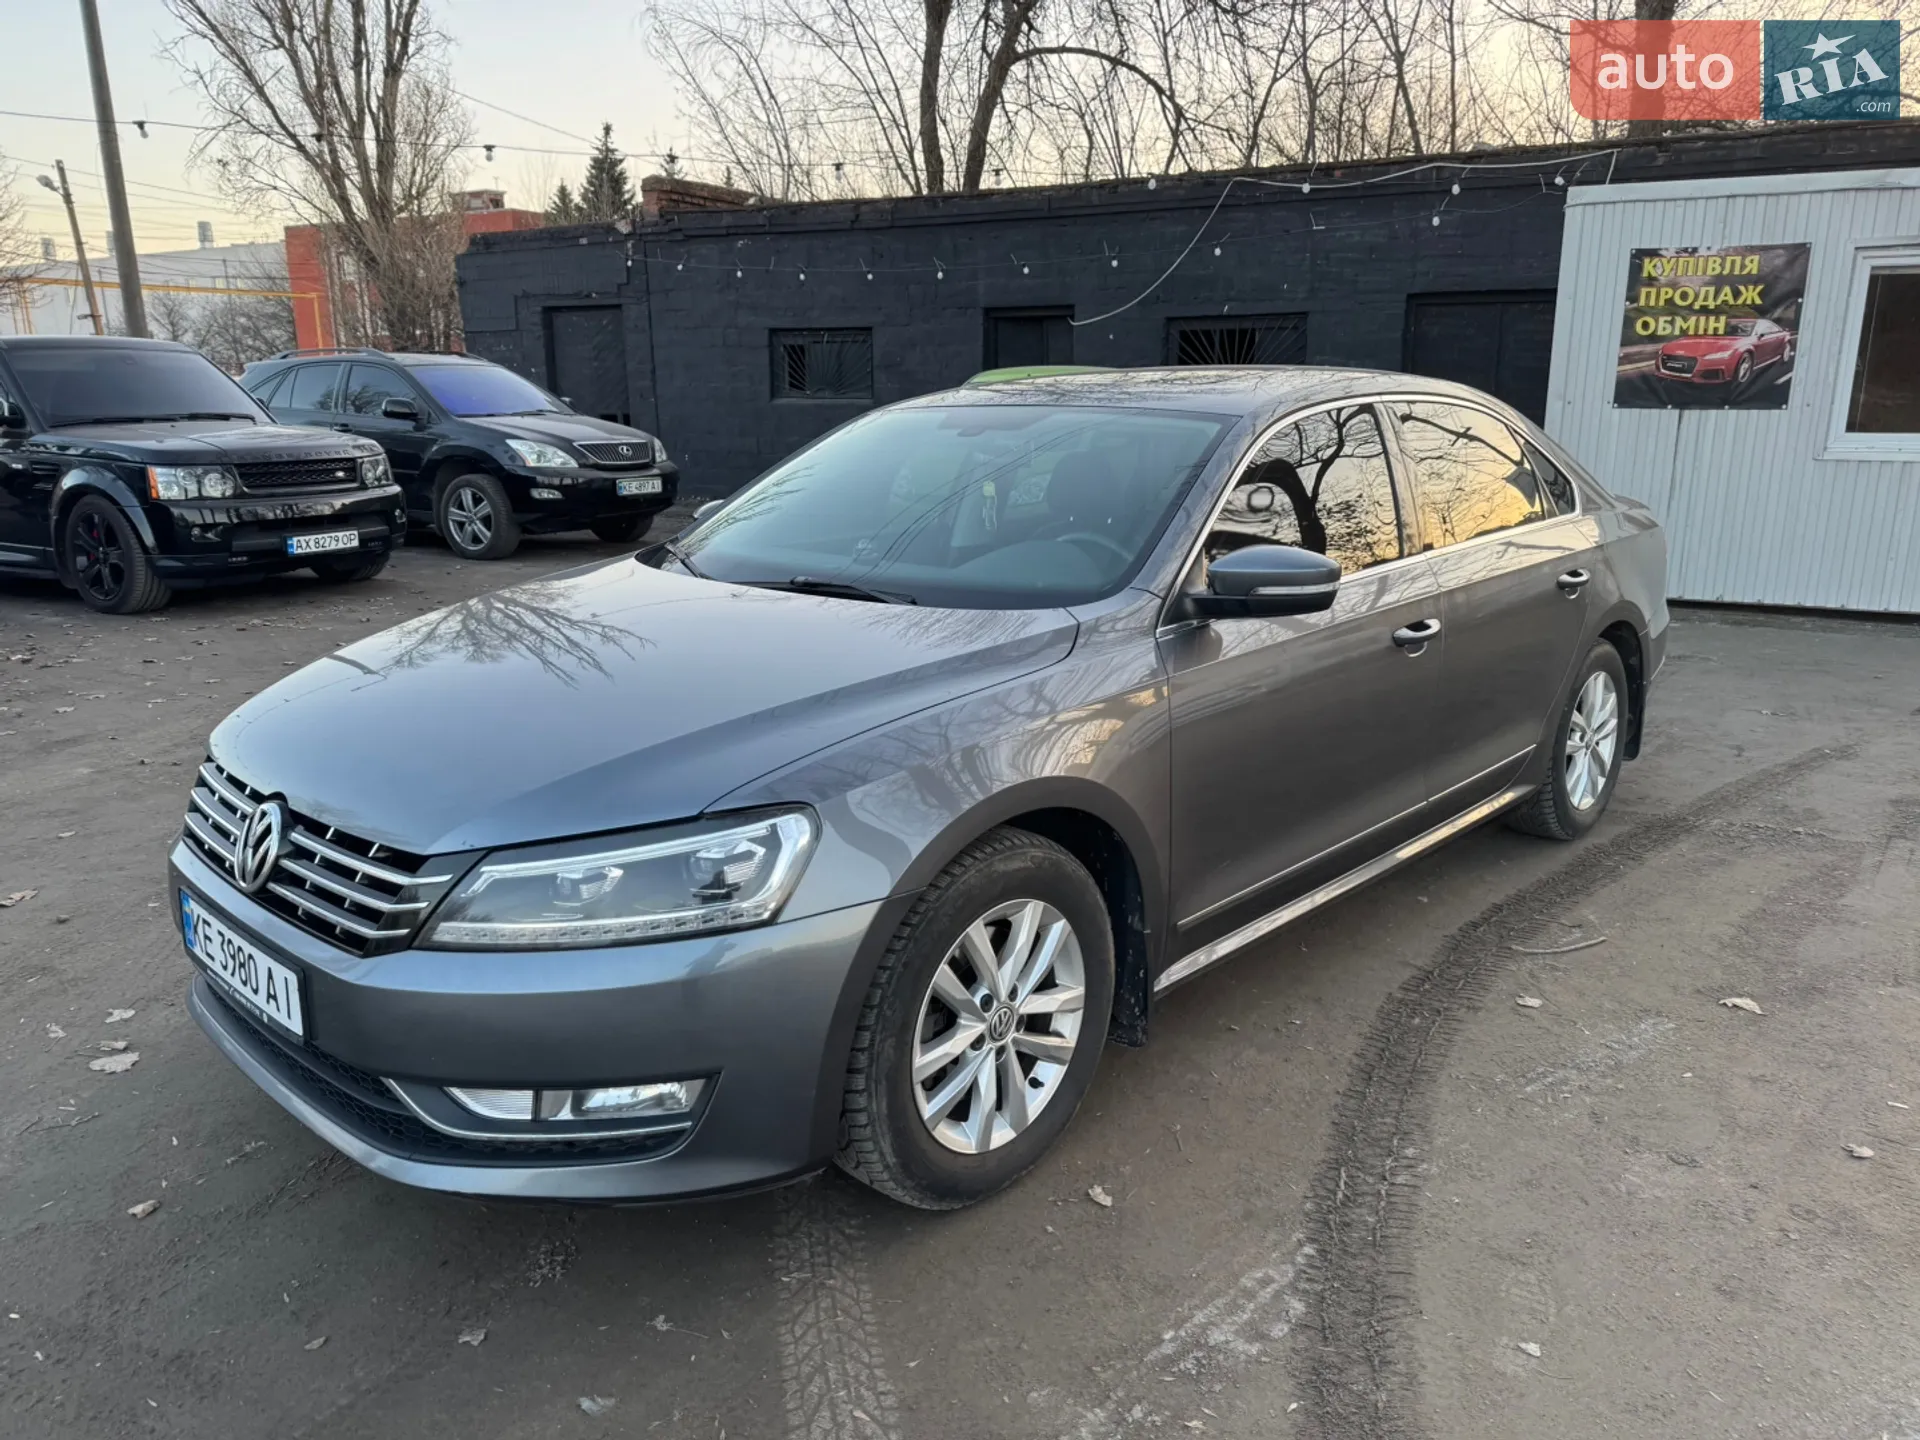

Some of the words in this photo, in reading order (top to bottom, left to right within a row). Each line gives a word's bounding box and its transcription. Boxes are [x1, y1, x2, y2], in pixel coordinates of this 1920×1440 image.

[1642, 255, 1760, 277] КУПІВЛЯ
[1639, 285, 1765, 309] ПРОДАЖ
[1635, 315, 1728, 336] ОБМІН
[296, 538, 312, 551] AX
[313, 535, 340, 549] 8279
[341, 533, 357, 546] OP
[191, 908, 216, 963] KE
[217, 929, 260, 996] 3980
[266, 966, 291, 1021] AI
